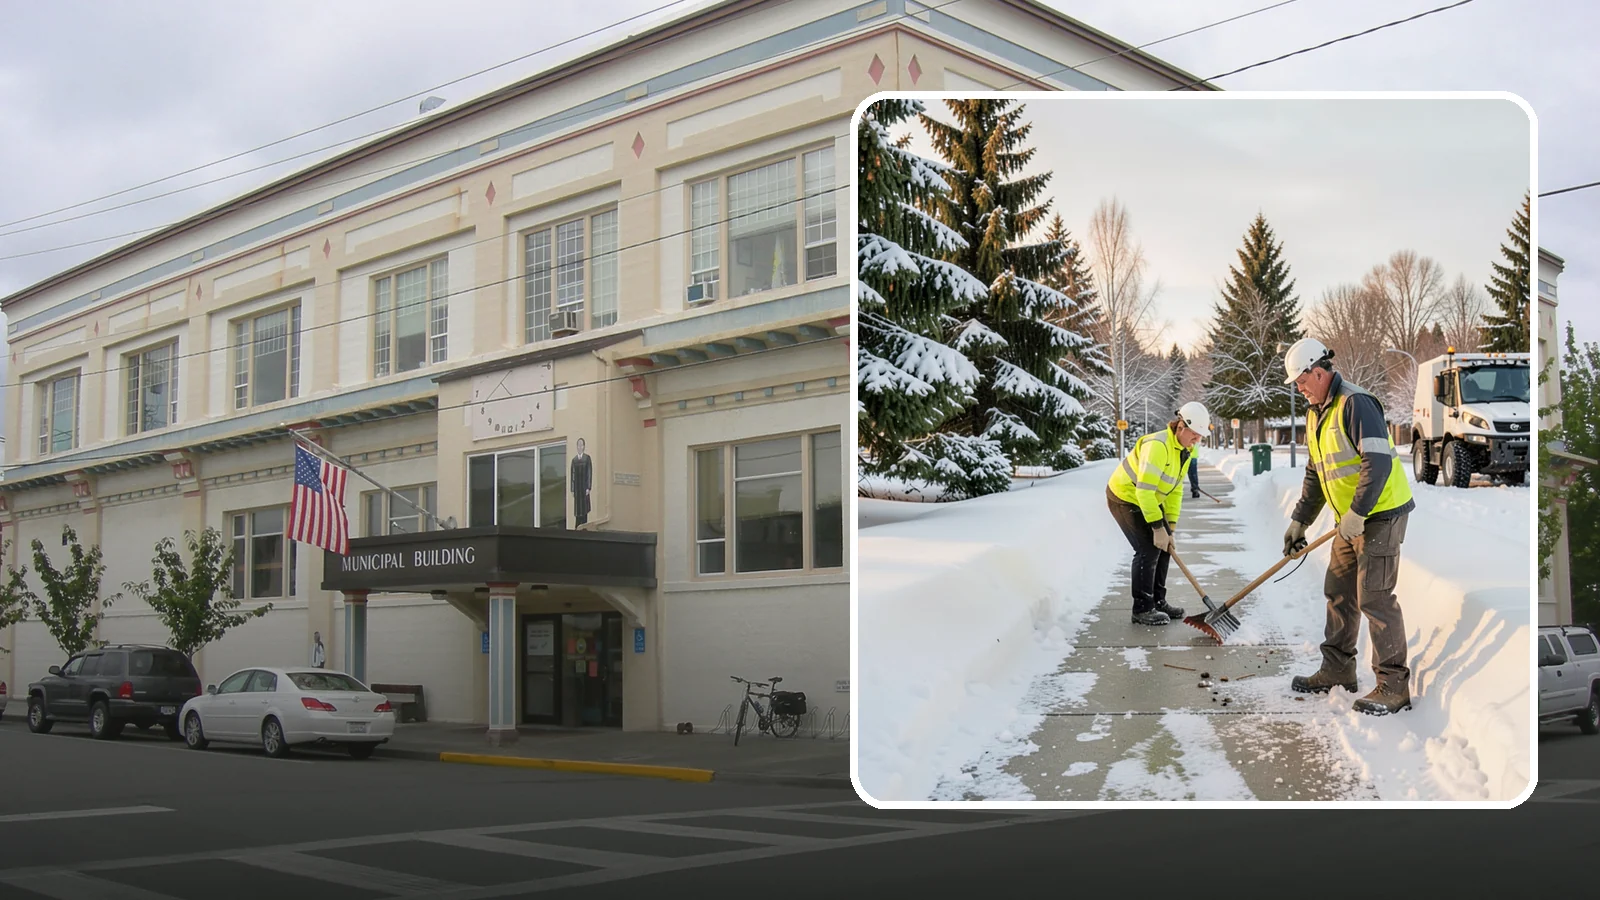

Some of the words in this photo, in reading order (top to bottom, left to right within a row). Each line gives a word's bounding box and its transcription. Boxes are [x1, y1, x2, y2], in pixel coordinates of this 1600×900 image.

[488, 418, 492, 426] 9
[342, 552, 405, 572] MUNICIPAL
[414, 546, 476, 567] BUILDING
